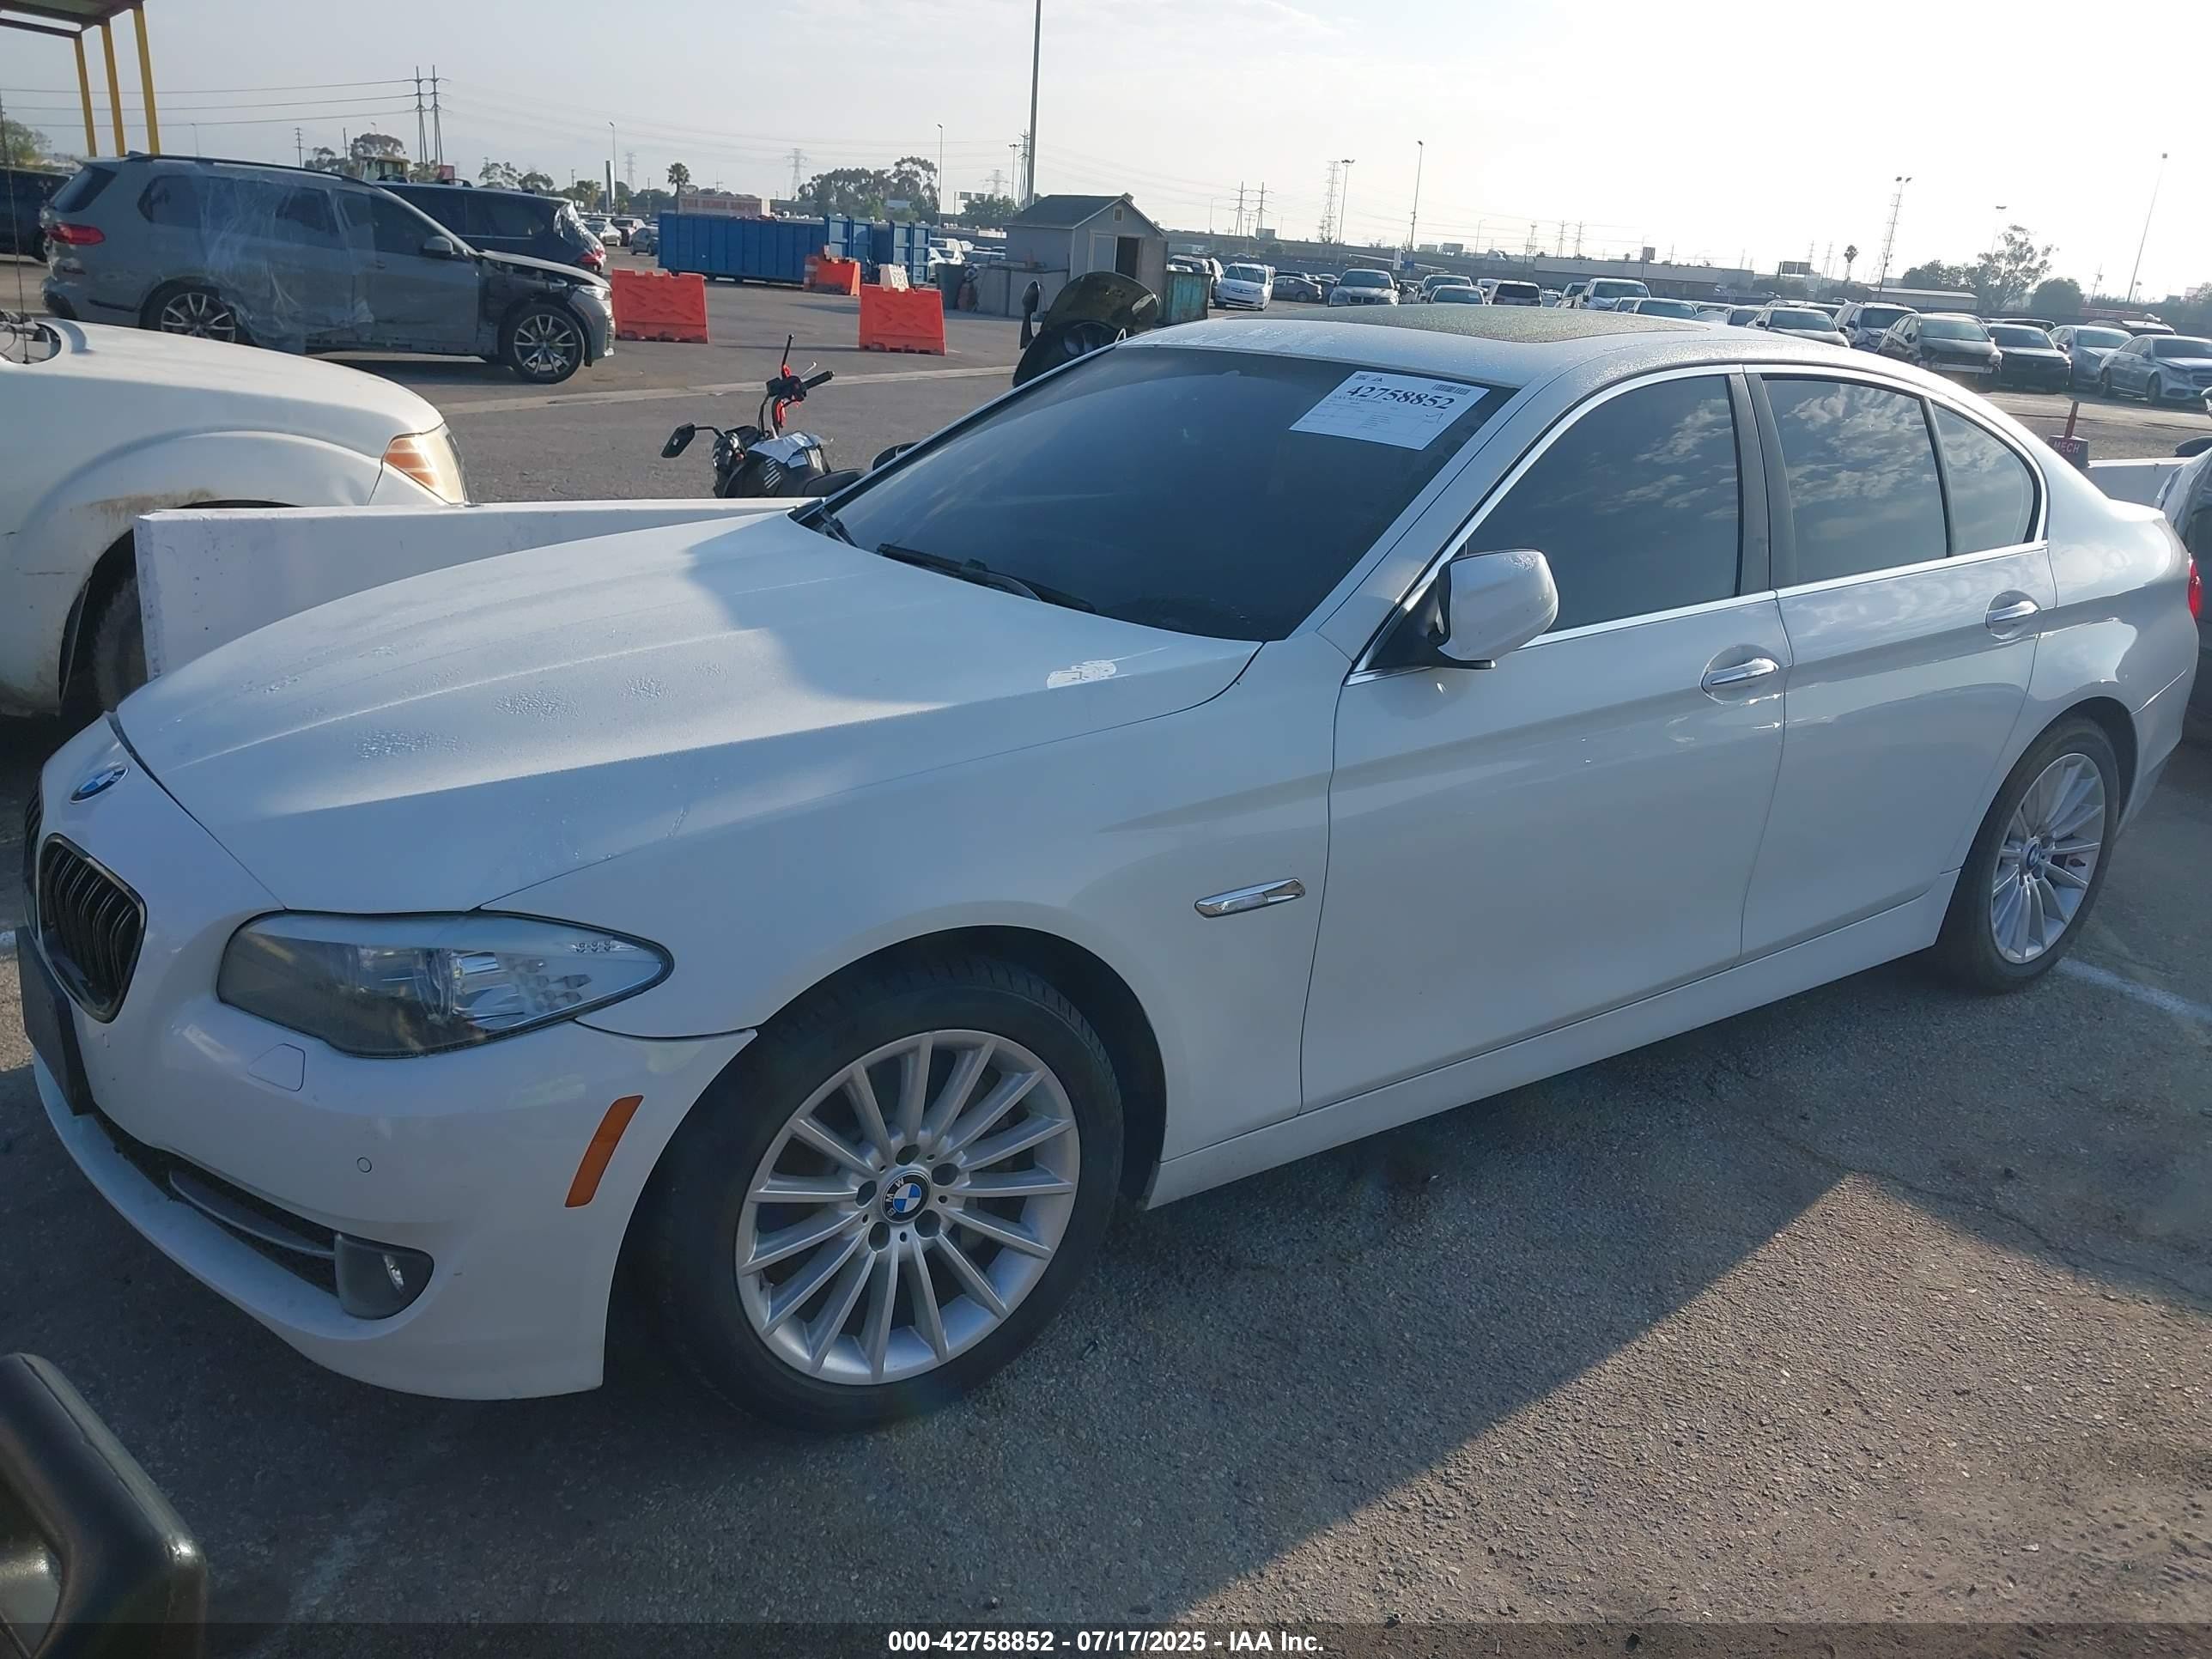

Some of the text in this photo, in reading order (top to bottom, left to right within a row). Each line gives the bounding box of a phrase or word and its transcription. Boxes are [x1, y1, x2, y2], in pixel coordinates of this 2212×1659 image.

[1346, 386, 1455, 410] 42758852
[2053, 440, 2081, 454] MECH
[884, 1177, 906, 1217] BMW
